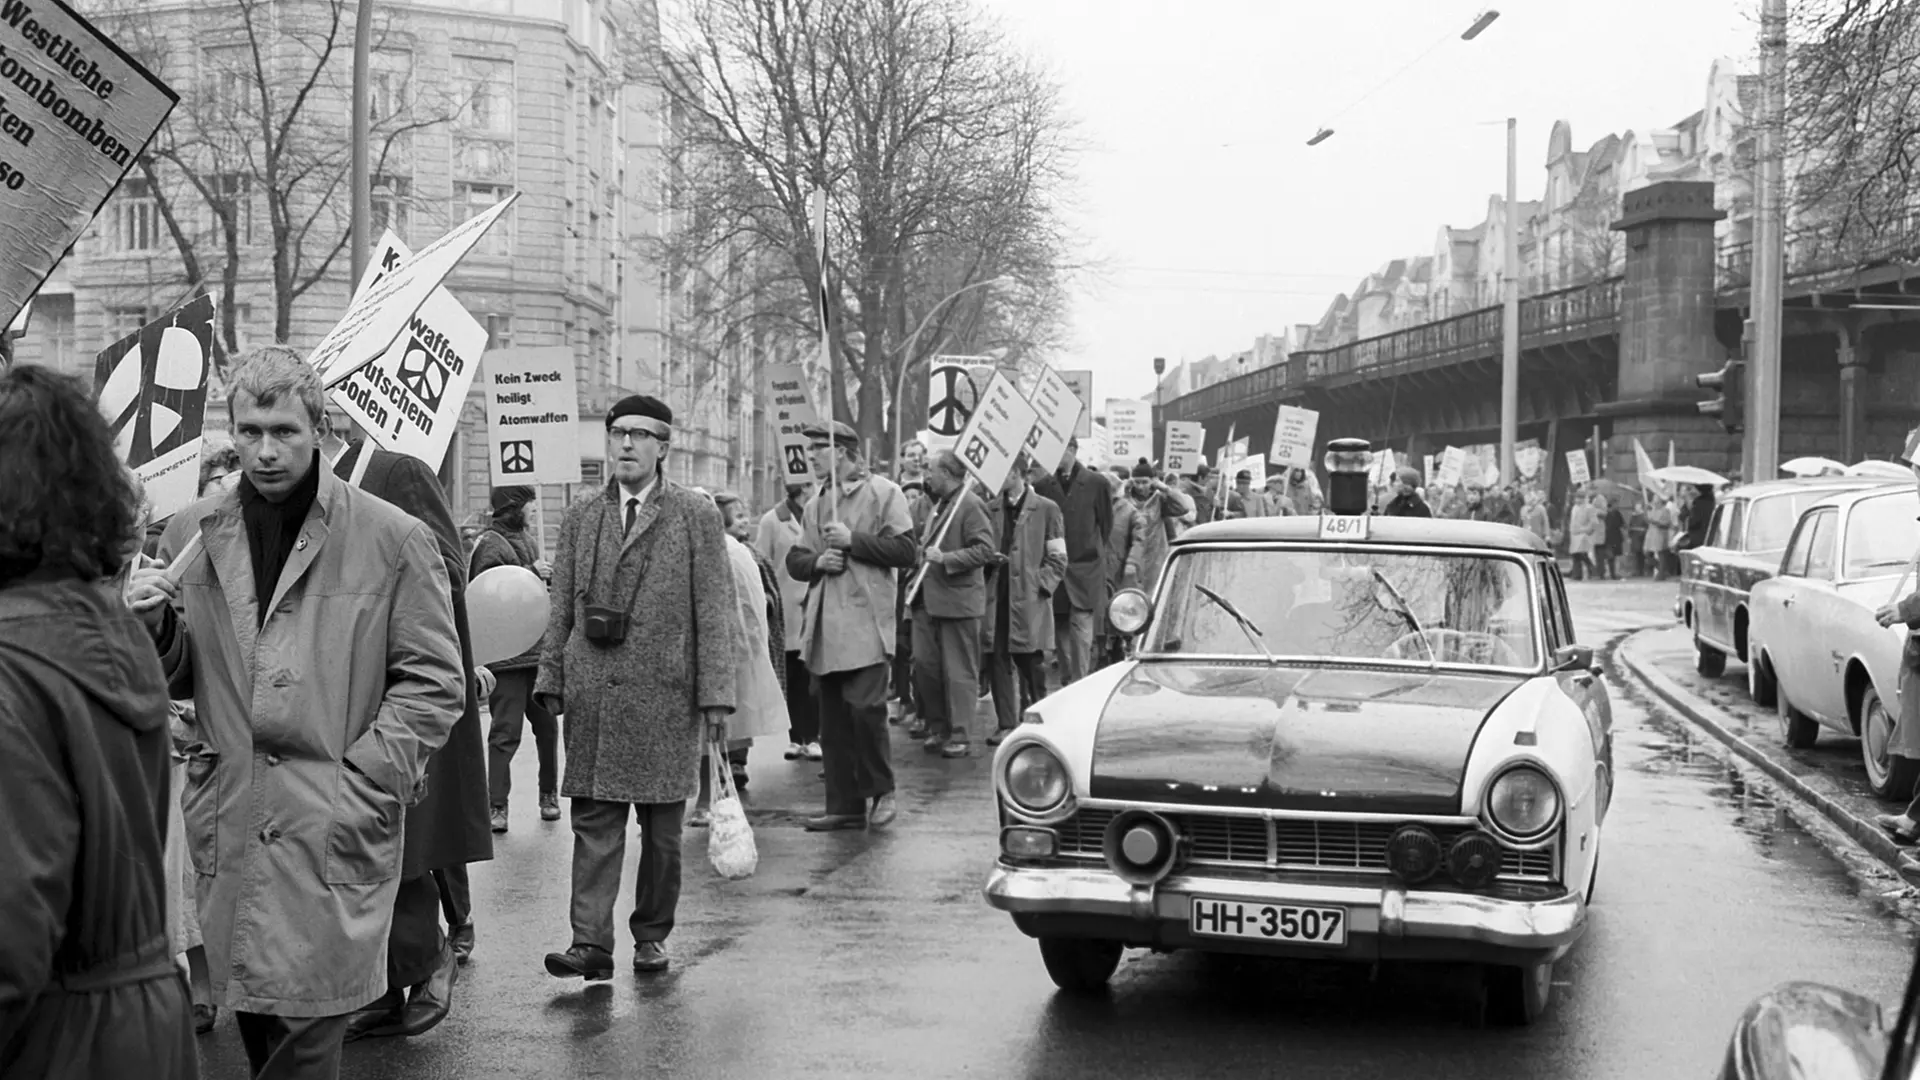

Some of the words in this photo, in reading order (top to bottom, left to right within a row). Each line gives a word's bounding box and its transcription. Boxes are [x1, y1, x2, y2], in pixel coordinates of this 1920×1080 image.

[1, 0, 114, 100] Westliche
[410, 313, 464, 376] waffen
[494, 373, 521, 384] Kein
[524, 370, 562, 383] Zweck
[360, 363, 433, 436] utschem
[496, 392, 532, 405] heiligt
[499, 412, 569, 425] Atomwaffen
[1326, 518, 1361, 534] 48/1
[1196, 901, 1341, 941] HH-3507
